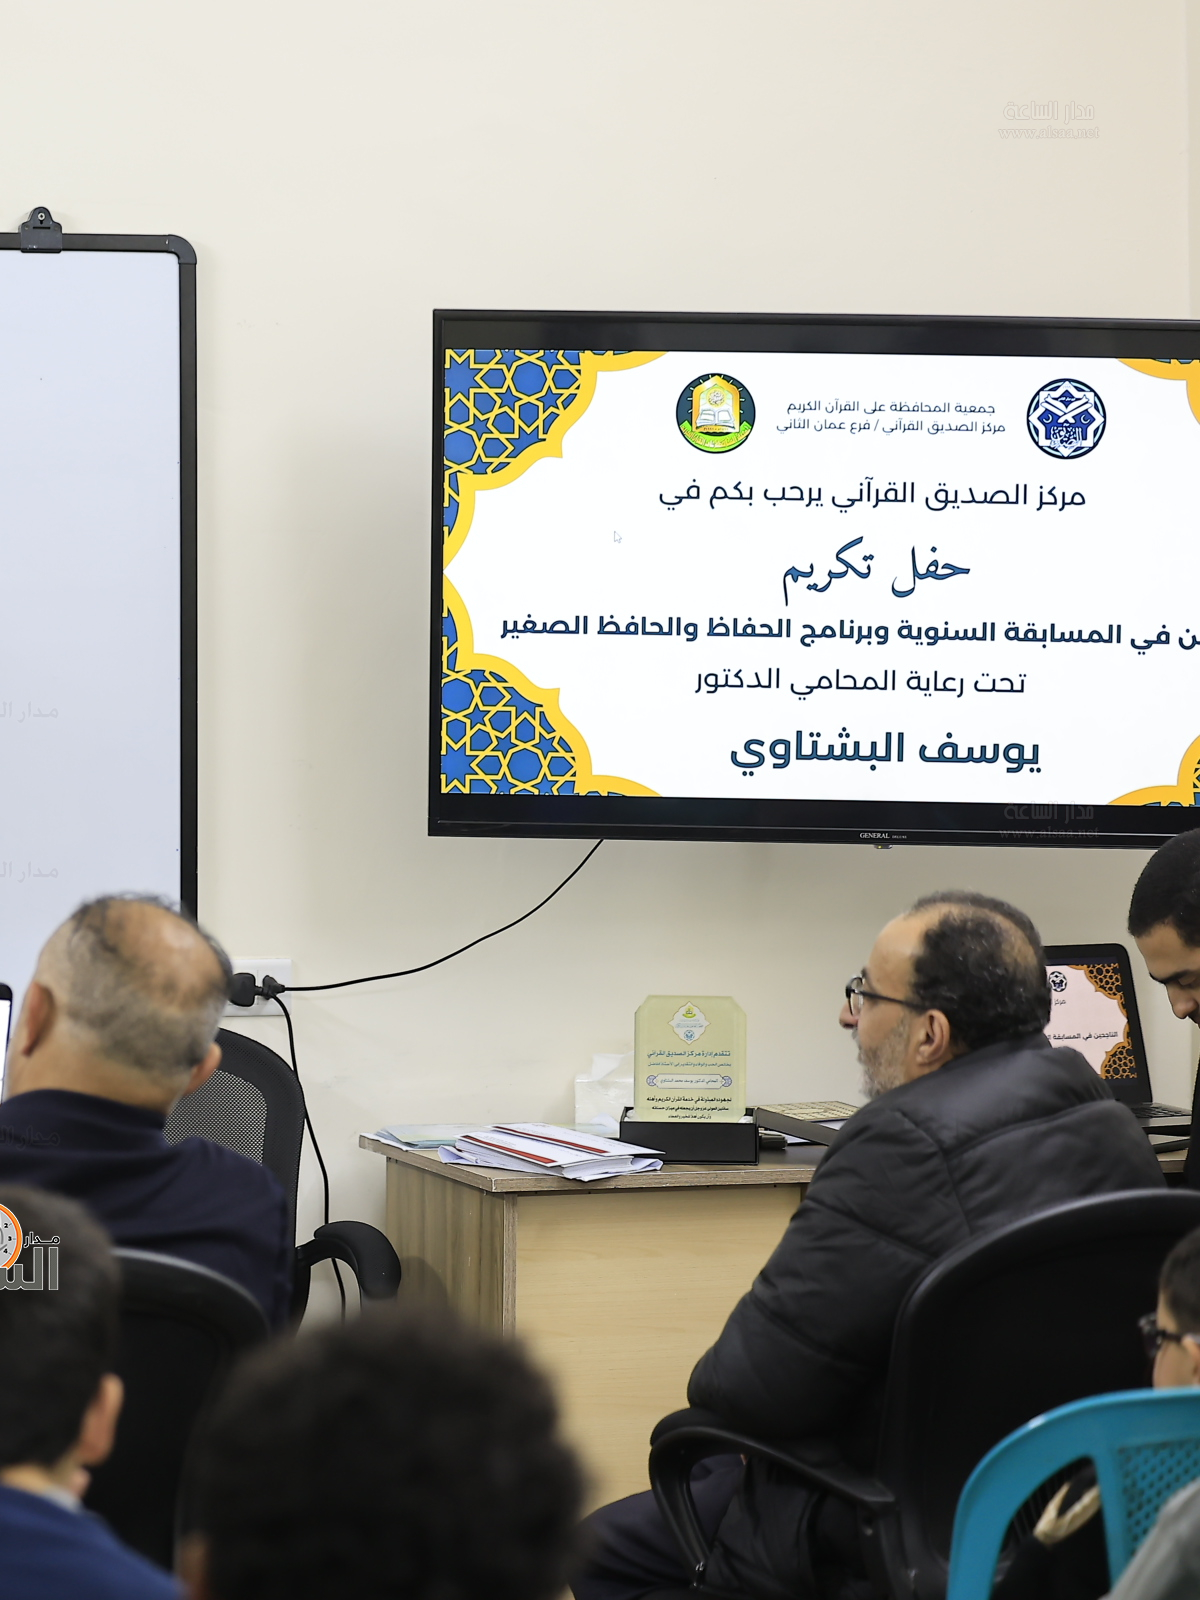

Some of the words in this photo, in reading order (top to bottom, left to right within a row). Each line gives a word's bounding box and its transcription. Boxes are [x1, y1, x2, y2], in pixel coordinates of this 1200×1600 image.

[787, 401, 820, 414] الكريم
[825, 399, 859, 414] القرآن
[864, 401, 885, 414] على
[890, 402, 950, 412] المحافظة
[955, 403, 995, 416] جمعية
[777, 418, 809, 431] الثاني
[814, 419, 845, 432] عمان
[850, 420, 870, 434] فرع
[874, 419, 879, 431] /
[882, 418, 922, 435] القرآني
[927, 421, 977, 435] الصديق
[981, 422, 1005, 434] مركز
[660, 479, 700, 510] في
[710, 481, 752, 509] بكم
[764, 486, 823, 507] يرحب
[832, 477, 914, 513] القرآني
[925, 483, 1027, 511] الصديق
[1037, 486, 1085, 511] مركز
[783, 536, 874, 606] تكريم
[892, 546, 970, 598] حفل
[501, 614, 588, 639] الصغير
[597, 615, 697, 642] والحافظ
[707, 617, 791, 637] الحفاظ
[800, 620, 888, 647] وبرنامج
[898, 620, 995, 646] السنوية
[1004, 622, 1121, 648] المسابقة
[1131, 625, 1170, 655] في
[695, 668, 779, 693] الدكتور
[791, 669, 895, 700] المحامي
[907, 671, 963, 698] رعاية
[974, 673, 1026, 693] تحت
[731, 727, 904, 776] البشتاوي
[919, 732, 1041, 773] يوسف
[1082, 1032, 1093, 1041] في
